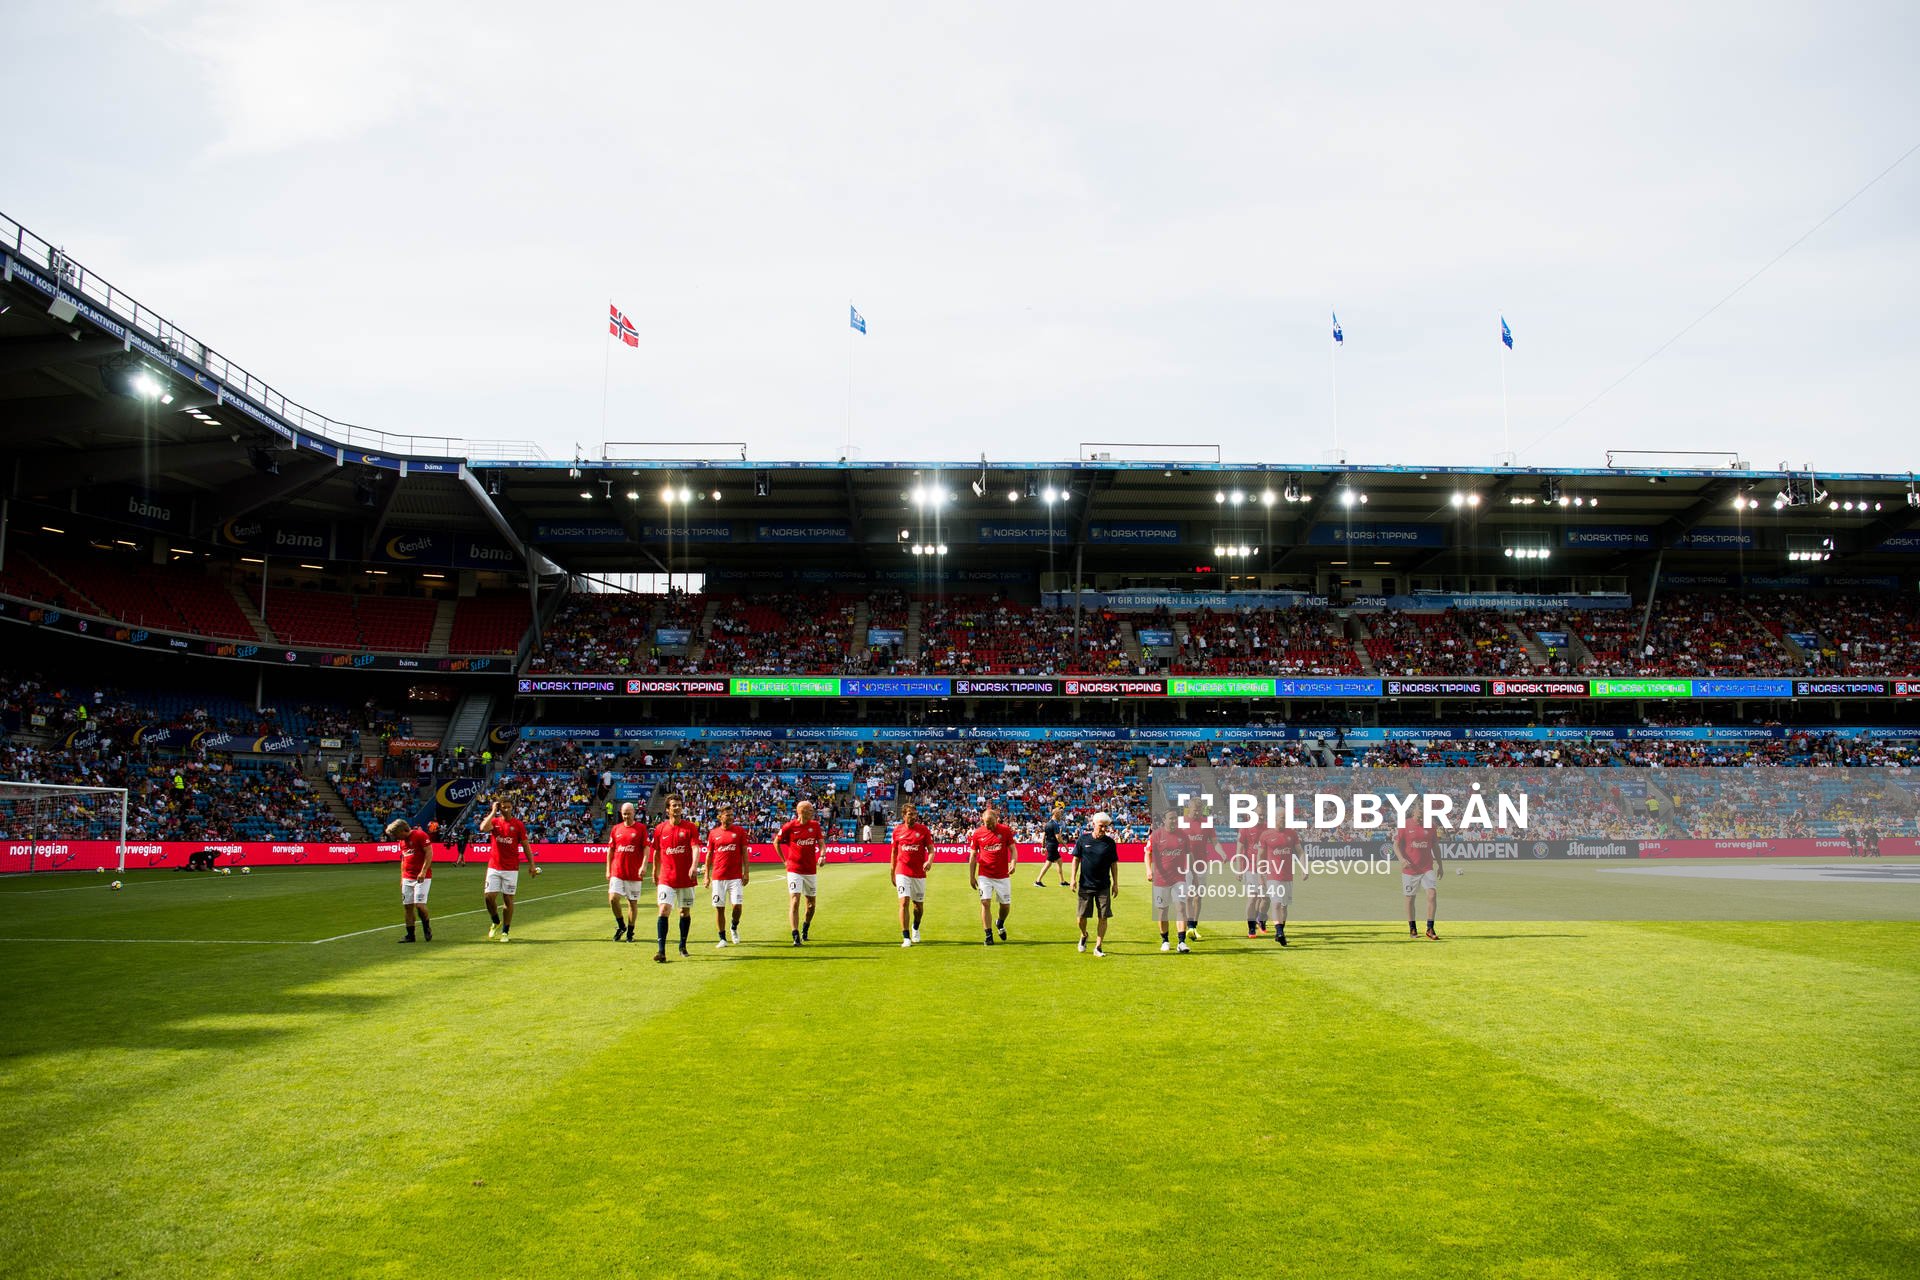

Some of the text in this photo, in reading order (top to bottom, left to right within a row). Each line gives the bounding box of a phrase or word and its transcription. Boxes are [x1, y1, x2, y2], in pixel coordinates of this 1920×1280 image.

[12, 262, 35, 280] SUNT
[77, 304, 89, 316] OG
[90, 310, 125, 336] AKTIVITET
[131, 335, 142, 346] GIR
[221, 390, 244, 408] OPPLEV
[129, 496, 170, 520] bama
[276, 529, 324, 548] bama
[399, 536, 432, 553] Bendit
[470, 544, 513, 560] bama
[237, 646, 258, 658] SLEEP
[353, 655, 375, 667] SLEEP
[399, 658, 418, 667] bama
[470, 658, 490, 672] SLEEP
[532, 682, 614, 690] NORSK TIPPING
[642, 682, 724, 691] NORSK TIPPING
[970, 683, 1052, 692] NORSK TIPPING
[1080, 684, 1161, 692] NORSK TIPPING
[1402, 684, 1480, 692] NORSK TIPPING
[1507, 684, 1584, 693] NORSK TIPPING
[1810, 684, 1884, 693] NORSK TIPPING
[74, 733, 97, 748] Bendit
[202, 732, 232, 749] Bendit
[264, 737, 295, 752] Bendit
[273, 844, 304, 854] norwegian
[329, 845, 355, 854] norwegian
[377, 844, 400, 853] norwegi
[1567, 842, 1626, 858] Aftenposten
[1715, 840, 1767, 849] norwegian
[1304, 844, 1363, 859] Aftenposten
